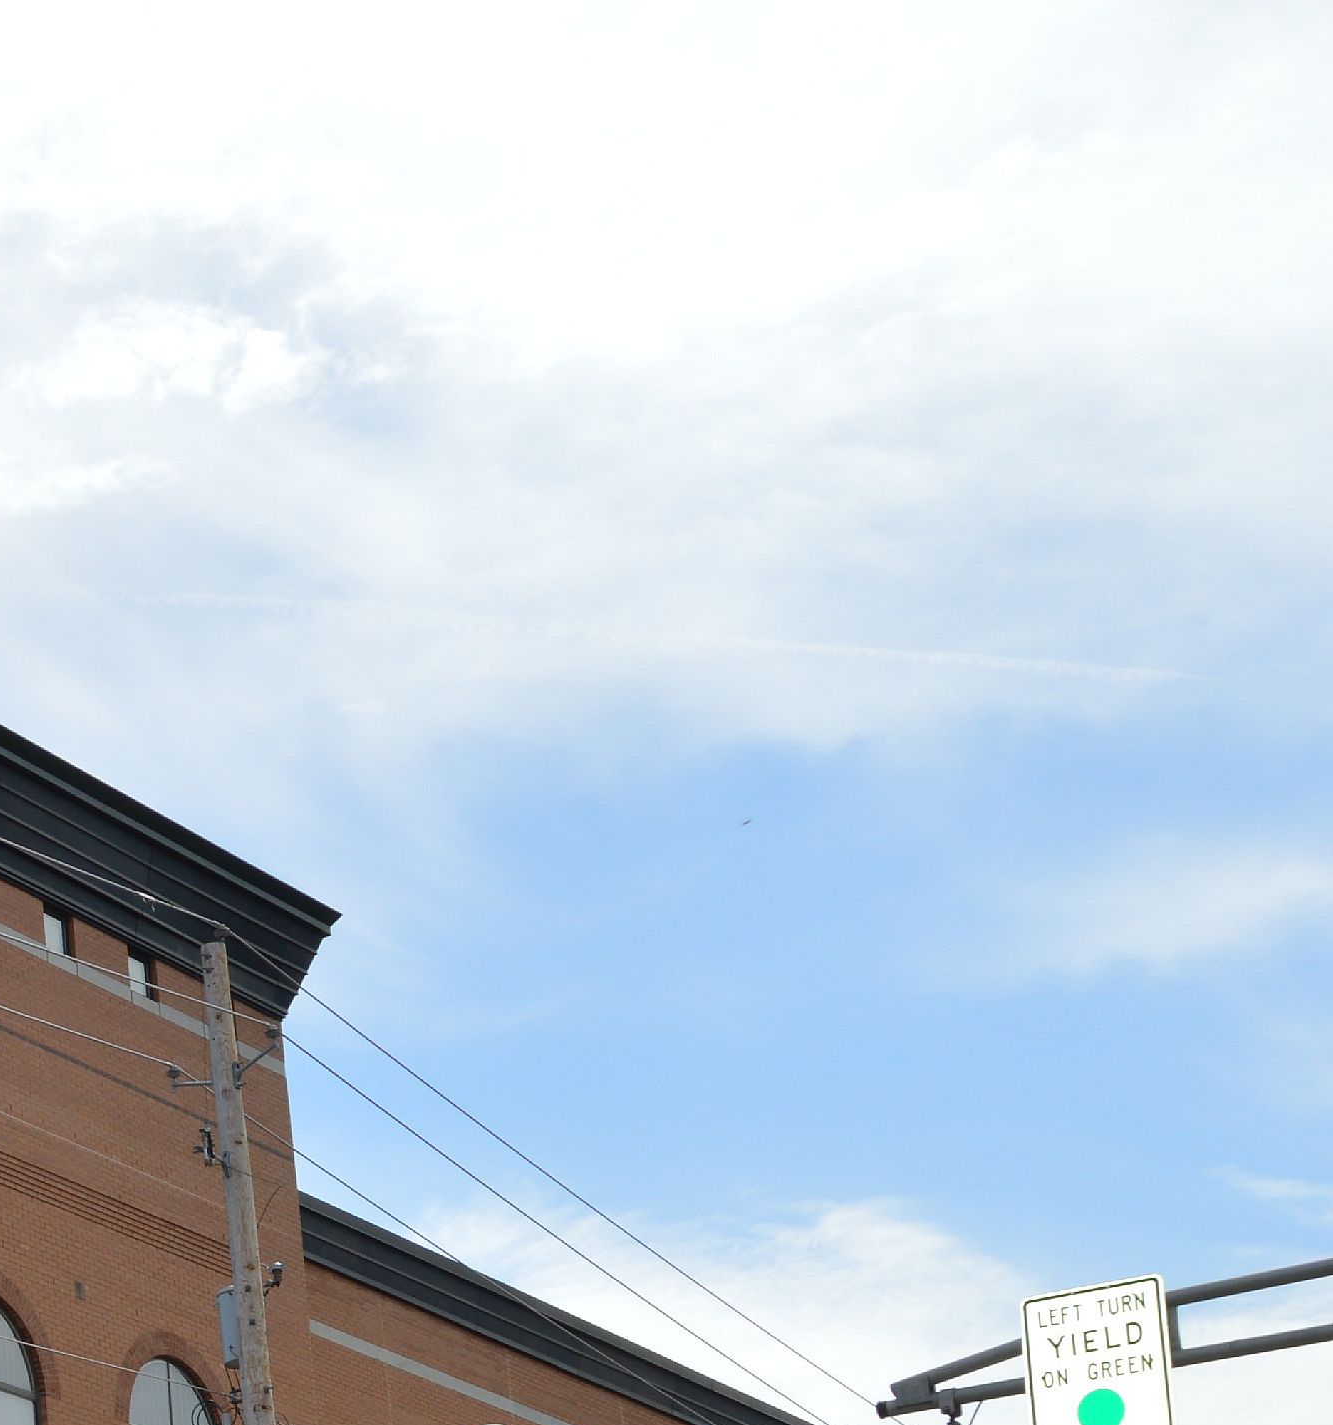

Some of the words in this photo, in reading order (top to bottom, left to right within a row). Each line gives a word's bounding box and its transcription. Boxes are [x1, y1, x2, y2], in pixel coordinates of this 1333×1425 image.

[1038, 1305, 1081, 1328] LEFT
[1097, 1293, 1146, 1317] TURN
[1047, 1322, 1143, 1359] YIELD
[1042, 1368, 1068, 1388] ON
[1088, 1354, 1154, 1381] GREEN
